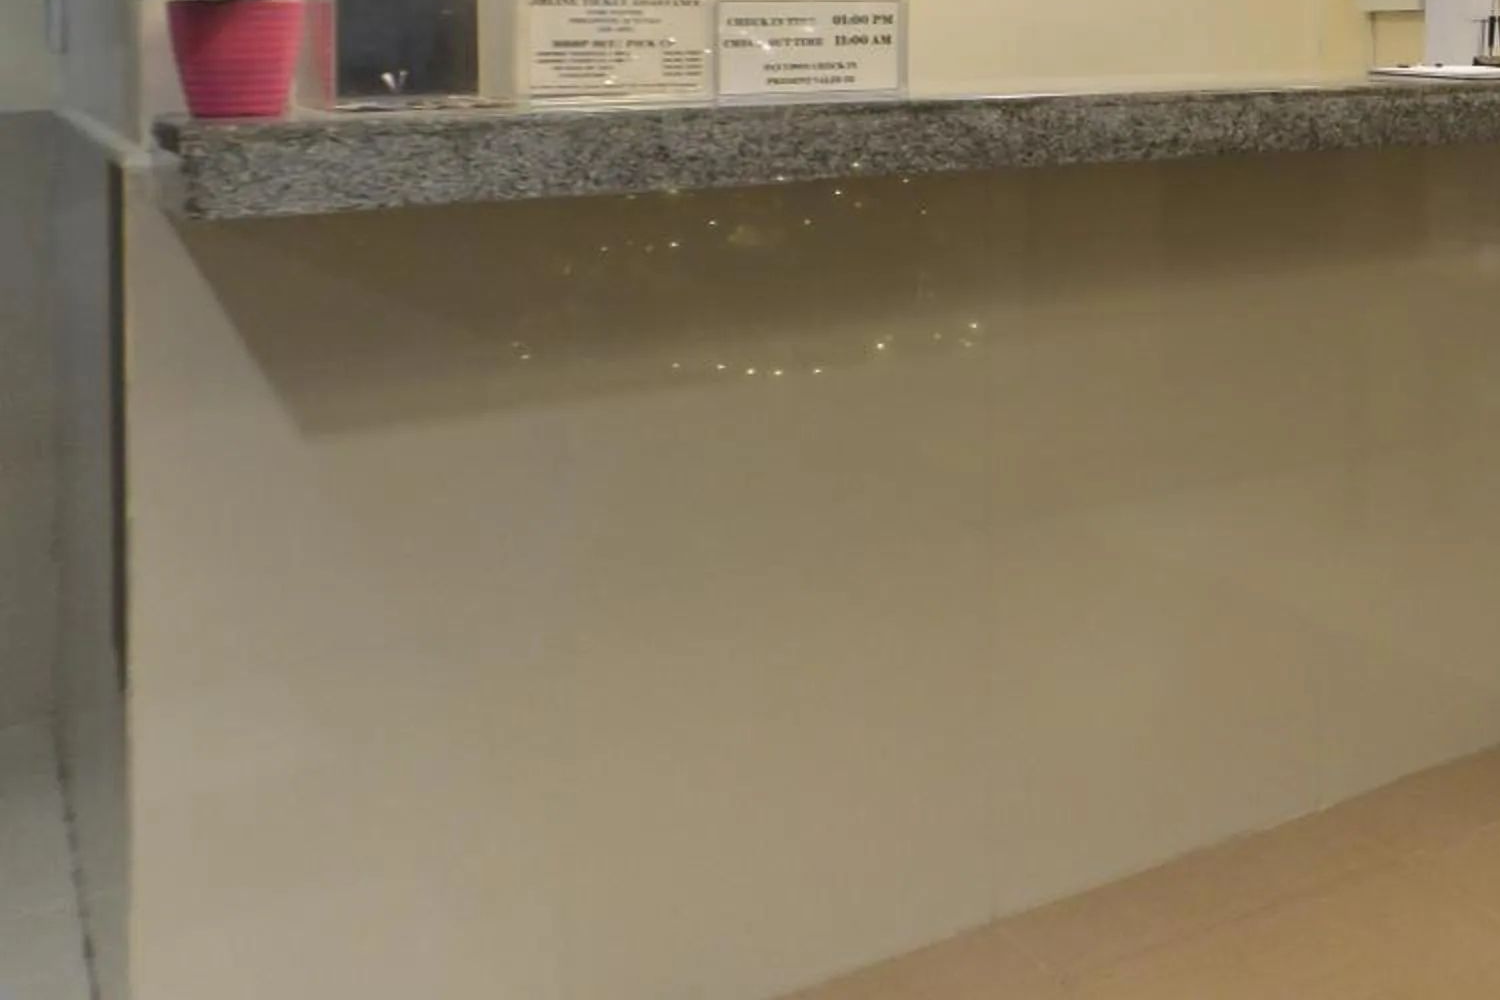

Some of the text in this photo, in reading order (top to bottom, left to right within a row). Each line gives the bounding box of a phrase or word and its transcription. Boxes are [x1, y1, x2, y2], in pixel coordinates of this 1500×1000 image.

[832, 14, 869, 25] 01:00
[872, 14, 893, 24] PM
[835, 35, 868, 46] 11:00
[872, 34, 892, 45] AM
